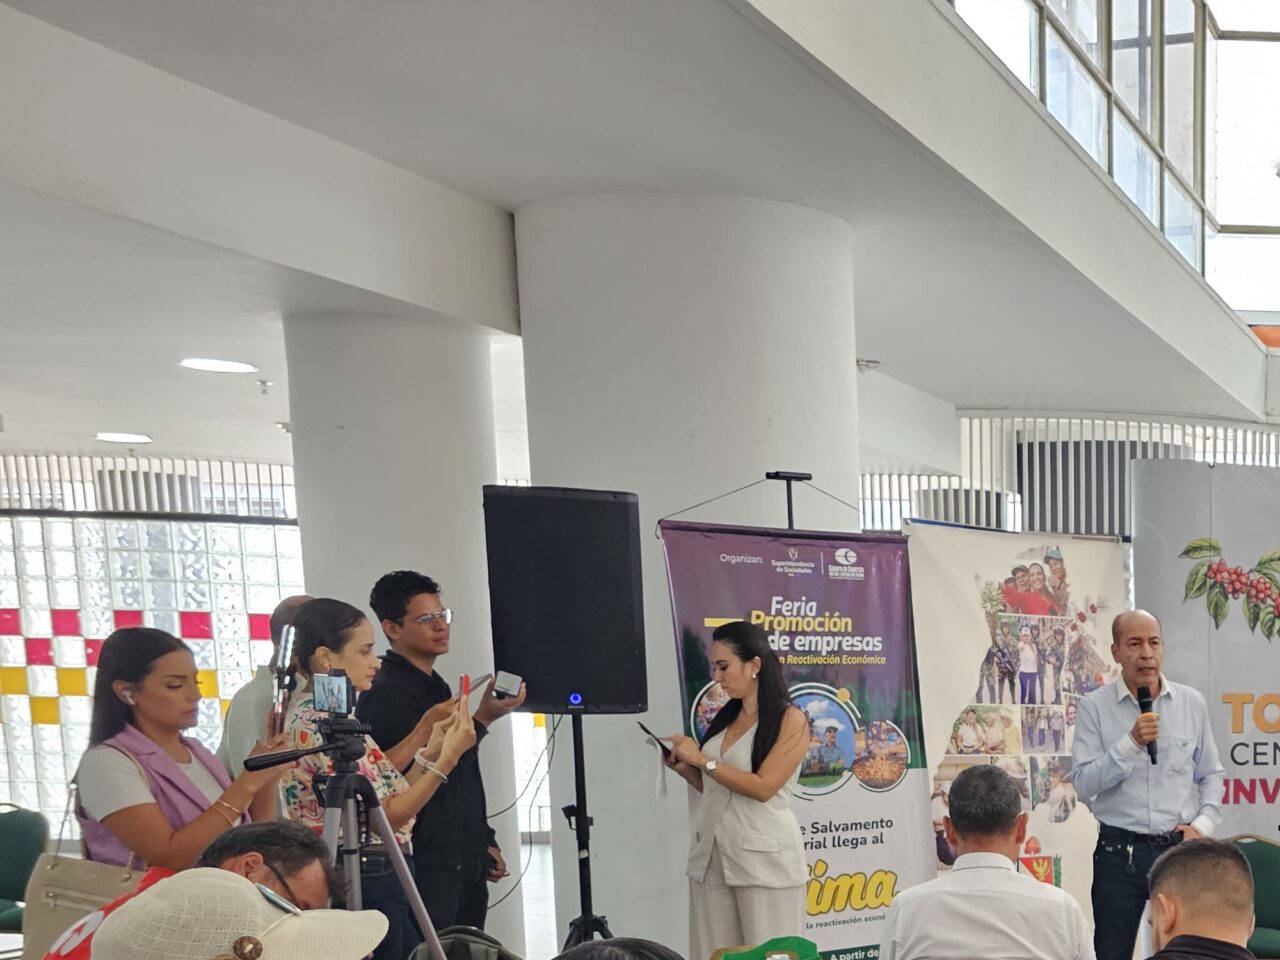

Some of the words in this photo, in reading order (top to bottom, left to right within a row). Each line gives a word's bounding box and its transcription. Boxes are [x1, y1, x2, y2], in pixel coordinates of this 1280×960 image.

[770, 596, 817, 617] Feria
[751, 610, 853, 633] Promoción
[767, 631, 791, 651] de
[794, 635, 883, 656] empresas
[787, 655, 841, 665] Reactivación
[842, 654, 886, 665] Económica
[810, 818, 894, 834] Salvamento
[832, 835, 868, 849] llega
[871, 832, 885, 845] al
[816, 916, 862, 928] reactivación
[867, 949, 879, 958] de
